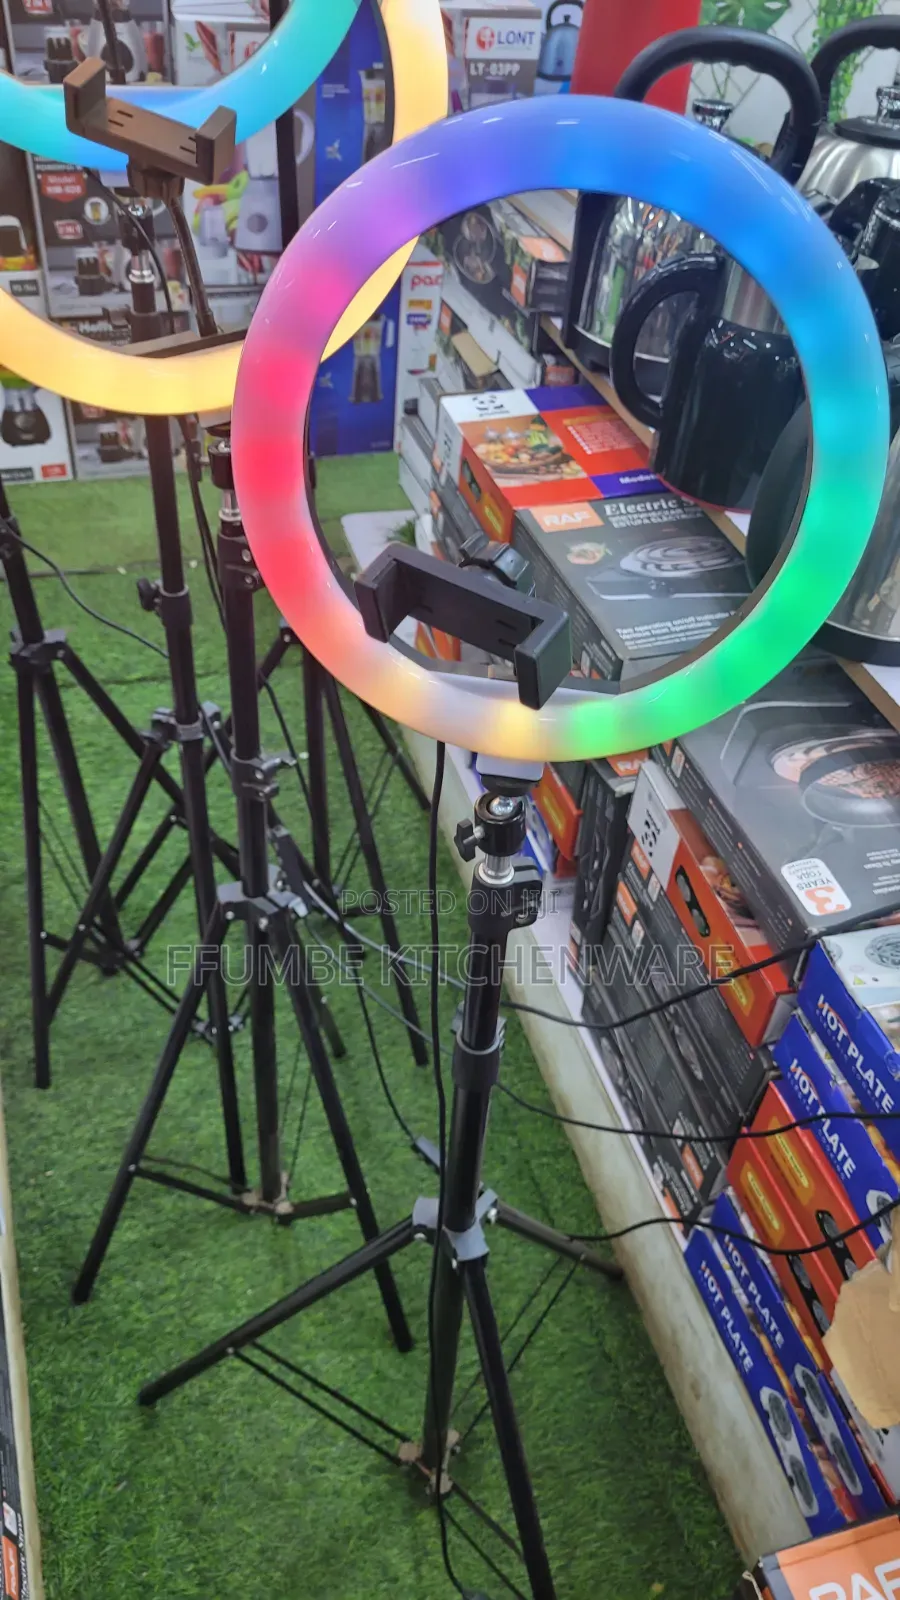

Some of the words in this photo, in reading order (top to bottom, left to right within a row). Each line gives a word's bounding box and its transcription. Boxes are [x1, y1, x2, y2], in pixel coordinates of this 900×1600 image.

[543, 510, 592, 527] RAF
[604, 498, 678, 516] Electric
[796, 877, 833, 890] YEARS
[805, 885, 846, 915] 3
[817, 994, 848, 1043] HOT
[847, 1041, 895, 1115] PLATE
[789, 1058, 819, 1105] HOT
[818, 1104, 857, 1179] PLATE
[700, 1260, 723, 1303] HOT
[721, 1305, 754, 1374] PLATE
[724, 1234, 749, 1278] HOT
[748, 1280, 785, 1349] PLATE
